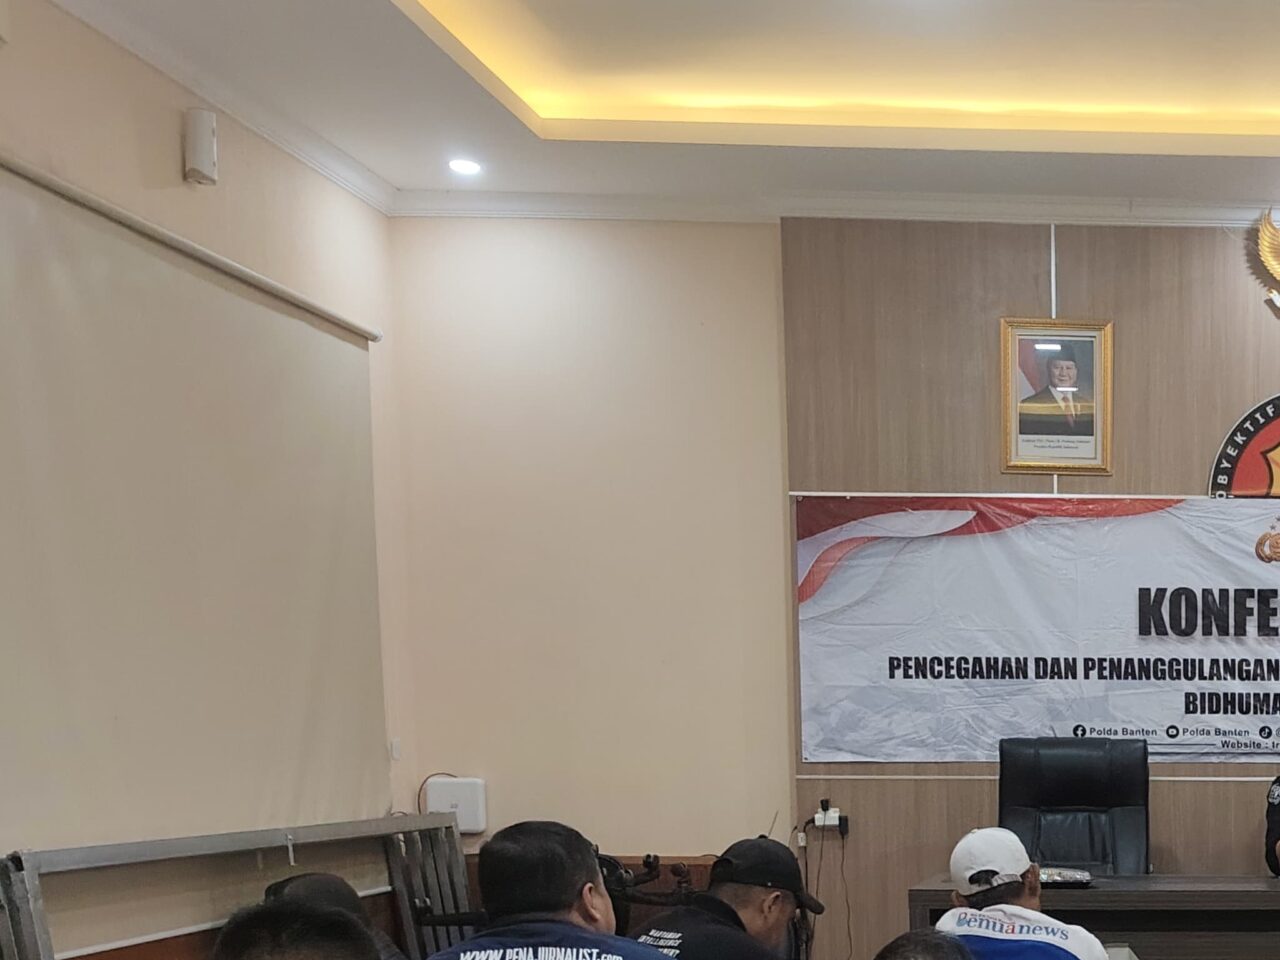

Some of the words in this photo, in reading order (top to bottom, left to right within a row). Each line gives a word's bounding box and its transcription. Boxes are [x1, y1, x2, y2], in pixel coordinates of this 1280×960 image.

[888, 656, 1028, 680] PENCEGAHAN
[1034, 657, 1077, 680] DAN
[1083, 657, 1280, 681] PENANGGULANGAN
[1089, 727, 1119, 737] Polda
[1121, 727, 1158, 737] Banten
[1182, 727, 1211, 737] Polda
[1214, 728, 1250, 737] Banten
[1220, 740, 1262, 749] Website
